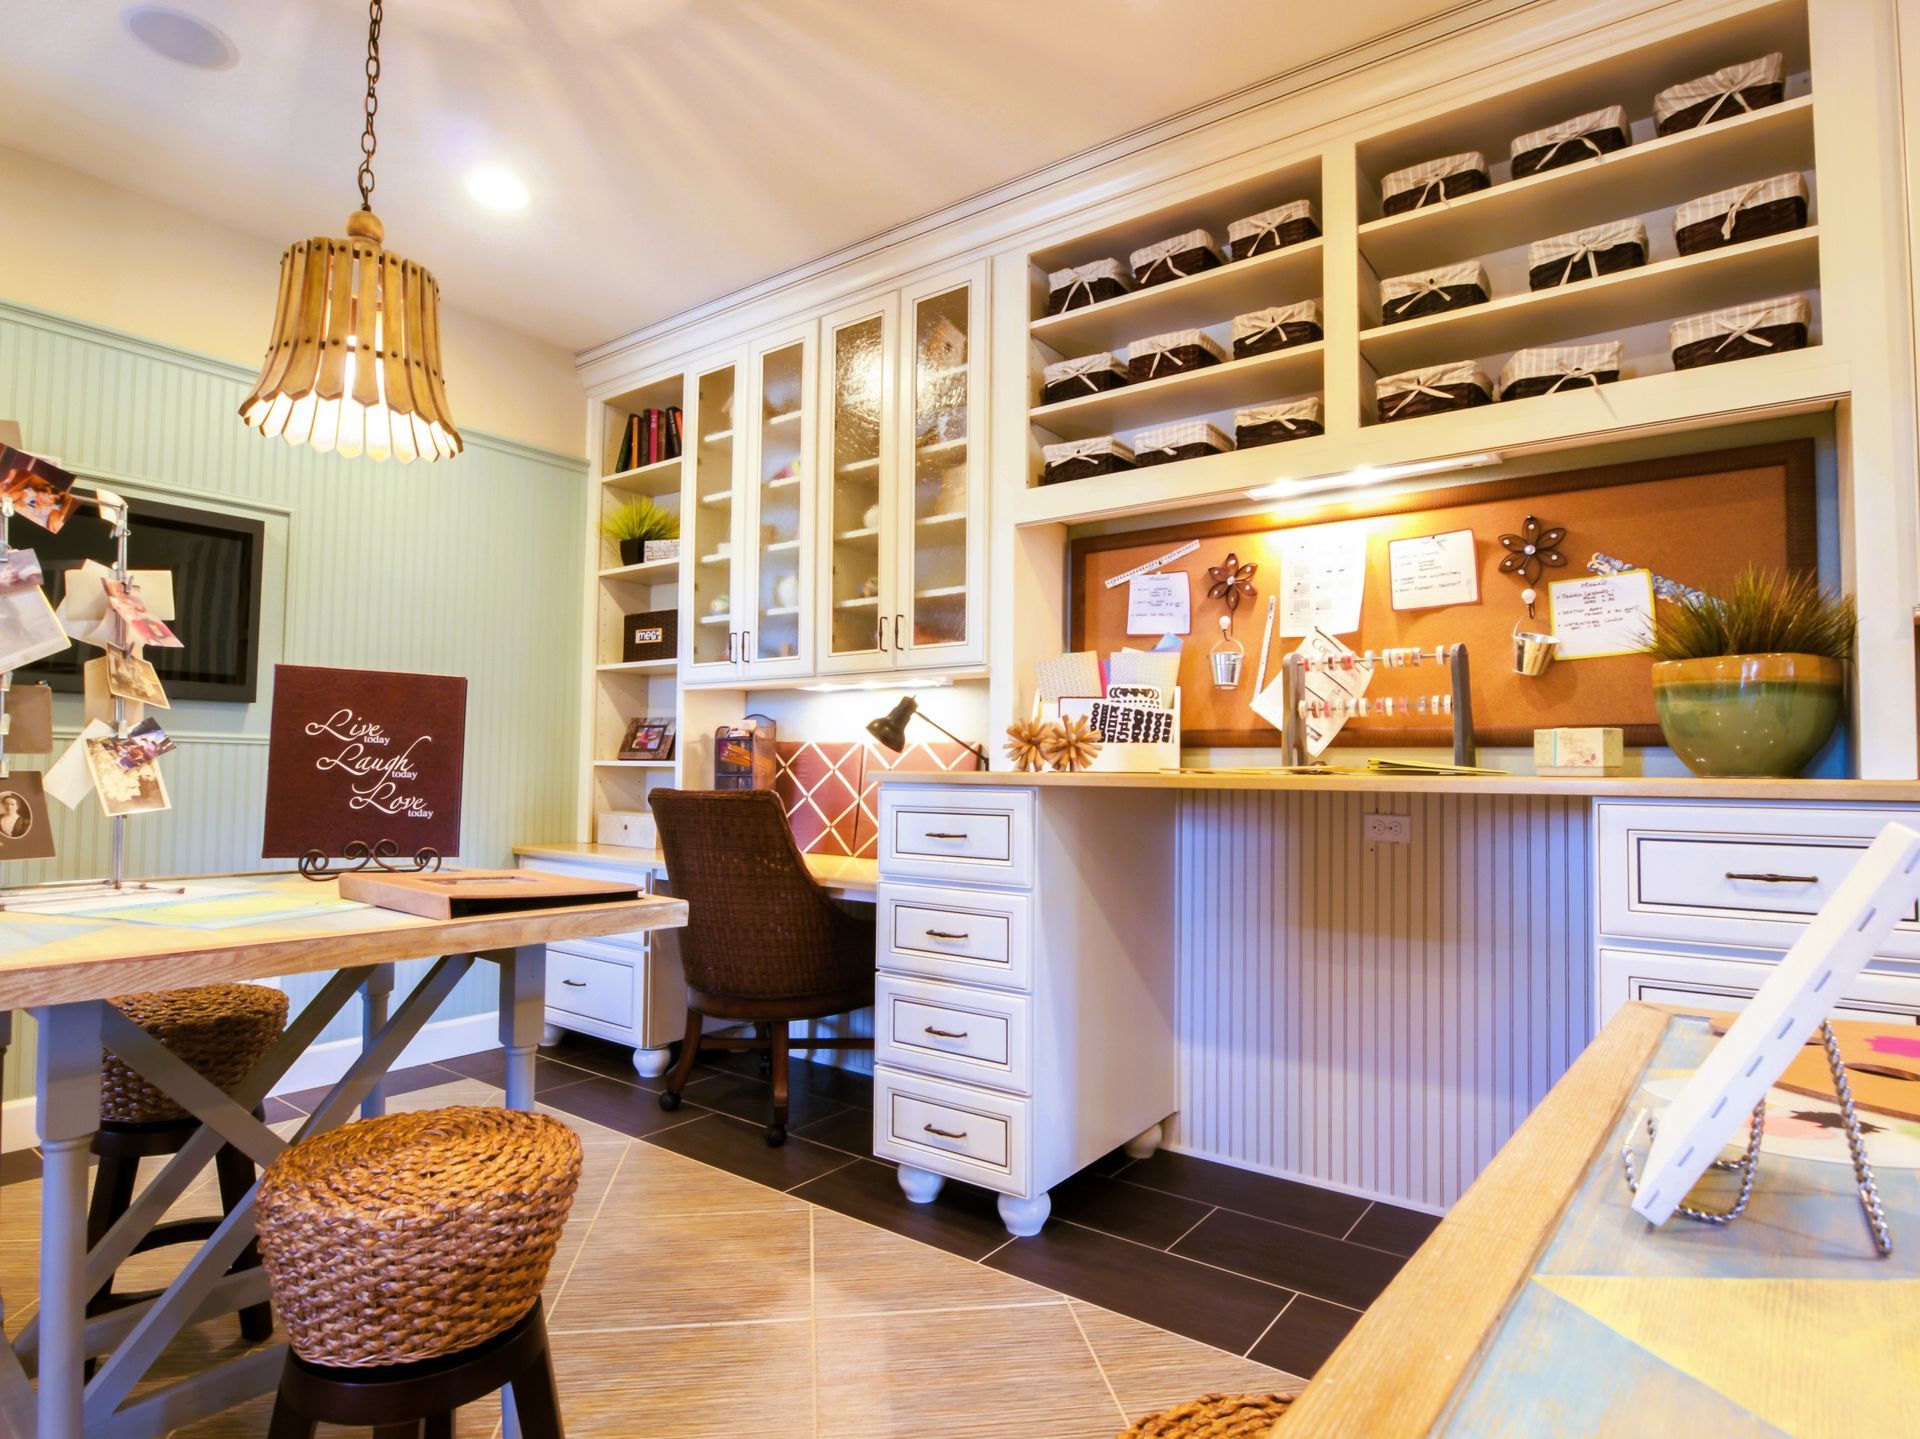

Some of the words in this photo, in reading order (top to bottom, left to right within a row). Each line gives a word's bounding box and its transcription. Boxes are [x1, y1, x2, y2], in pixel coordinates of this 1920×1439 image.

[305, 708, 384, 741] Live
[364, 735, 391, 746] today
[316, 736, 432, 794] Laugh
[391, 769, 418, 781] today
[350, 782, 427, 814] Love
[407, 809, 434, 820] today
